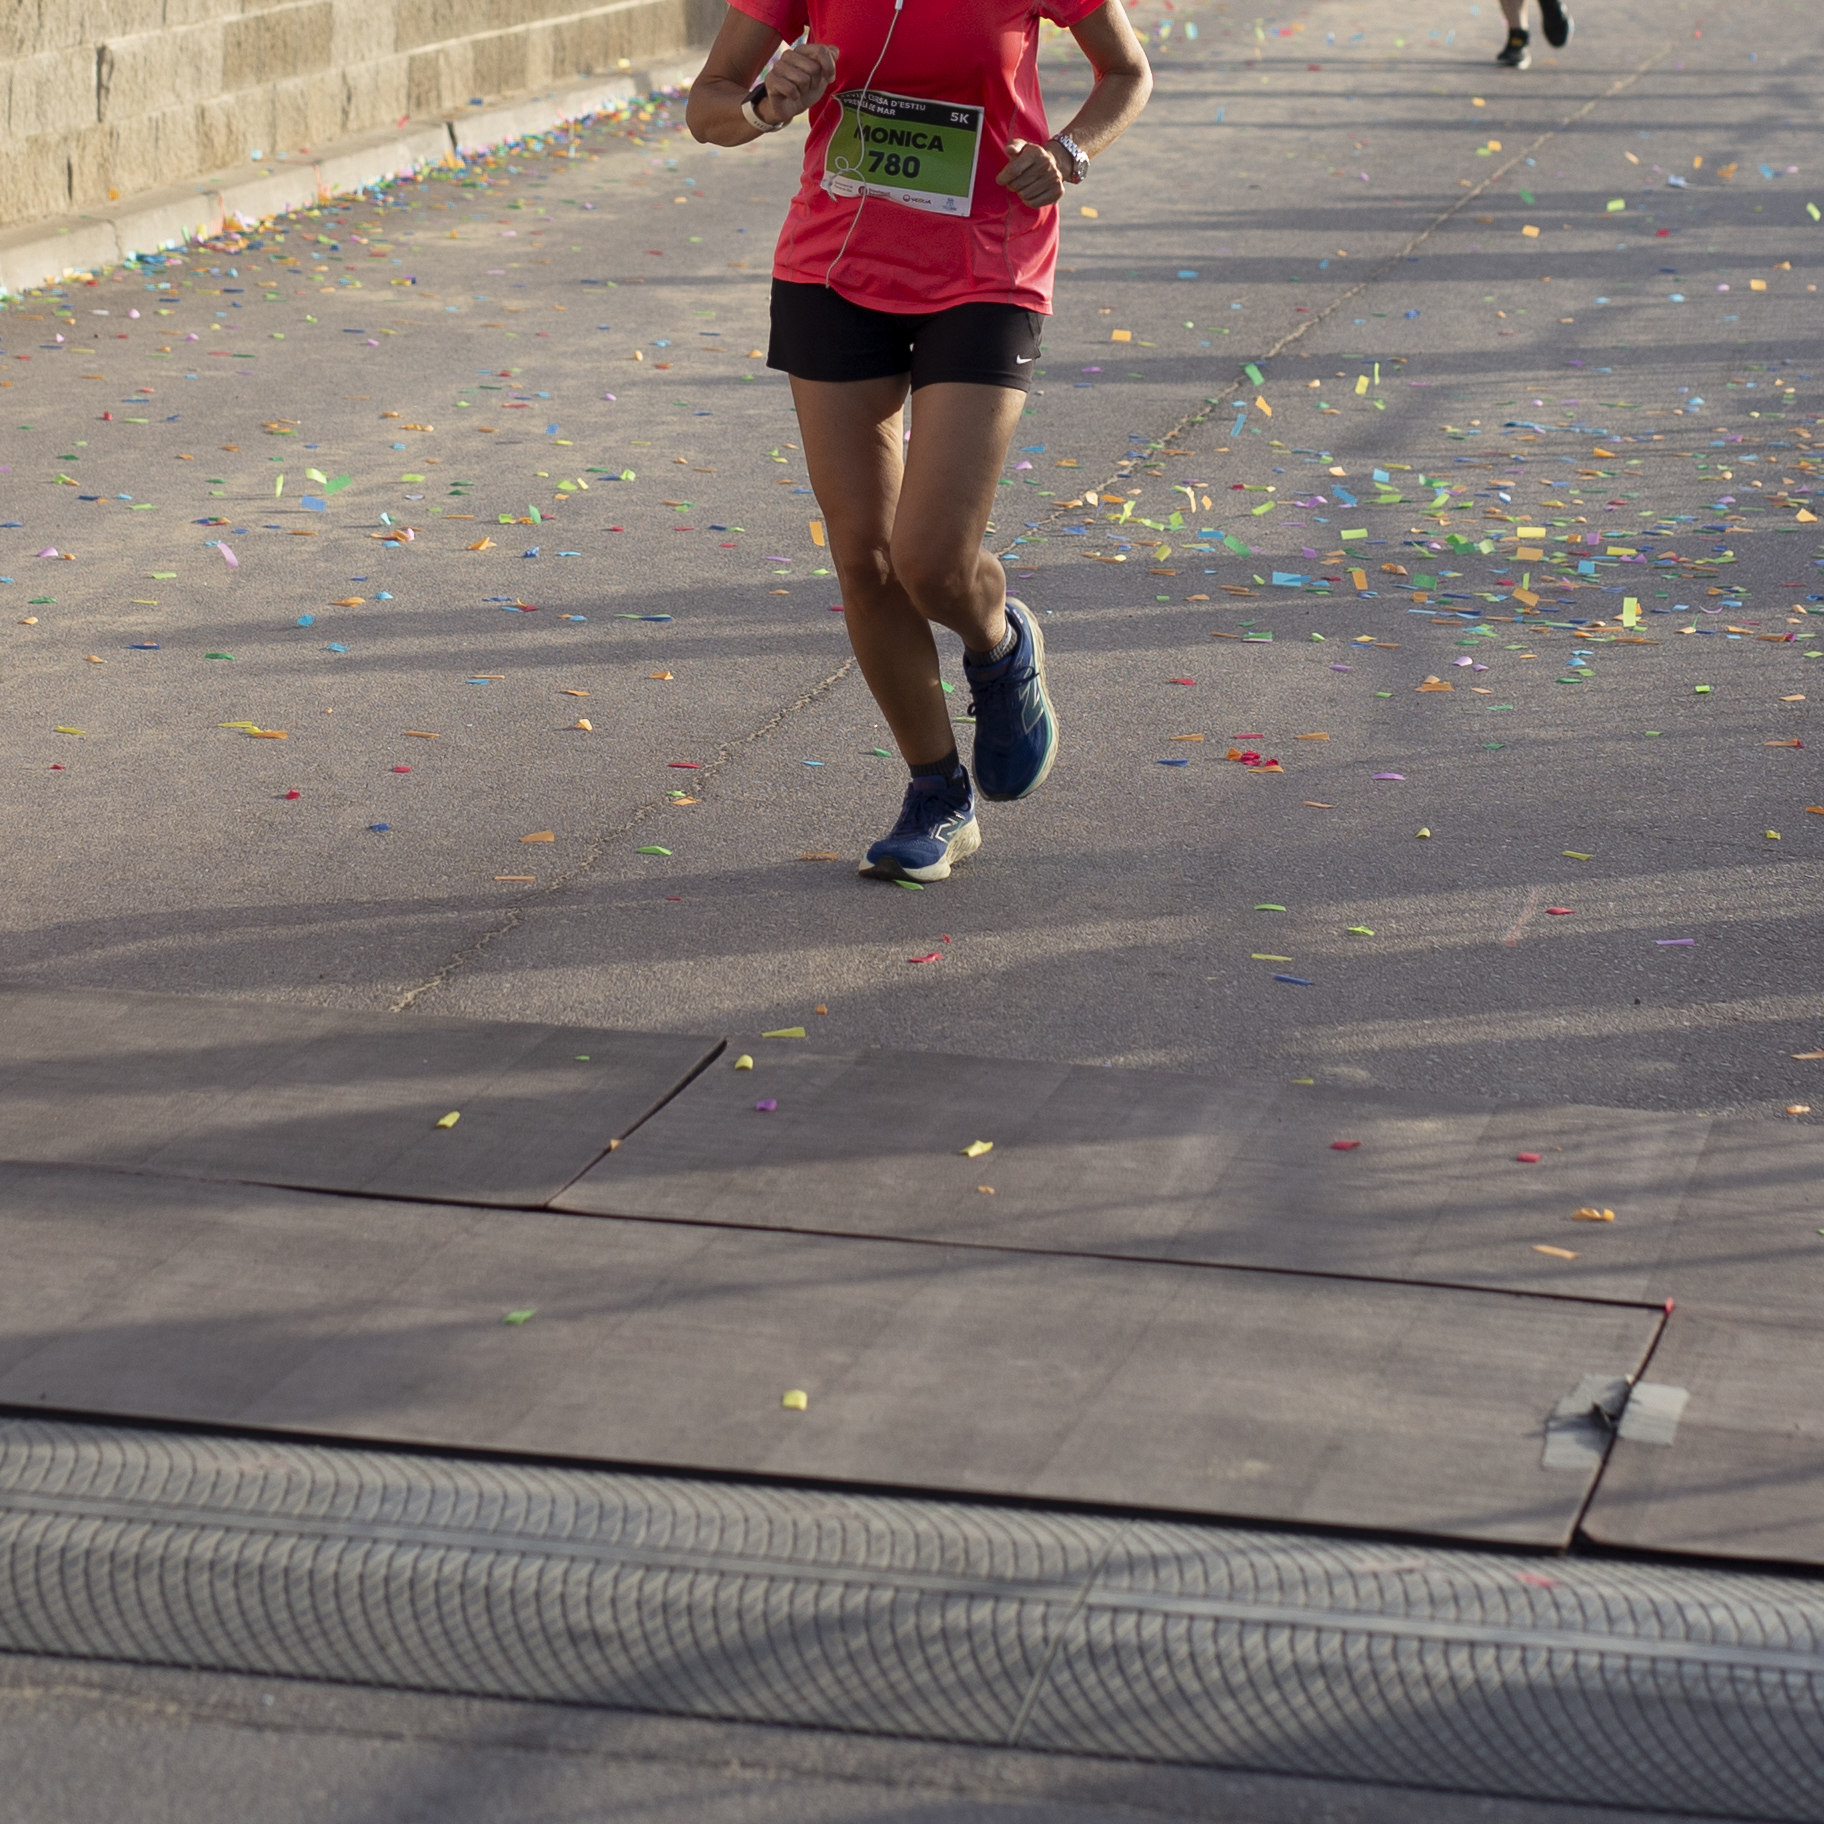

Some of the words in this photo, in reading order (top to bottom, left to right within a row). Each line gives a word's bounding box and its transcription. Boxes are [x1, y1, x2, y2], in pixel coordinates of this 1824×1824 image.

[877, 106, 896, 116] MAR
[891, 100, 926, 111] D'ESTIU
[950, 112, 969, 124] 5K
[853, 125, 944, 152] MONICA
[868, 150, 921, 179] 780
